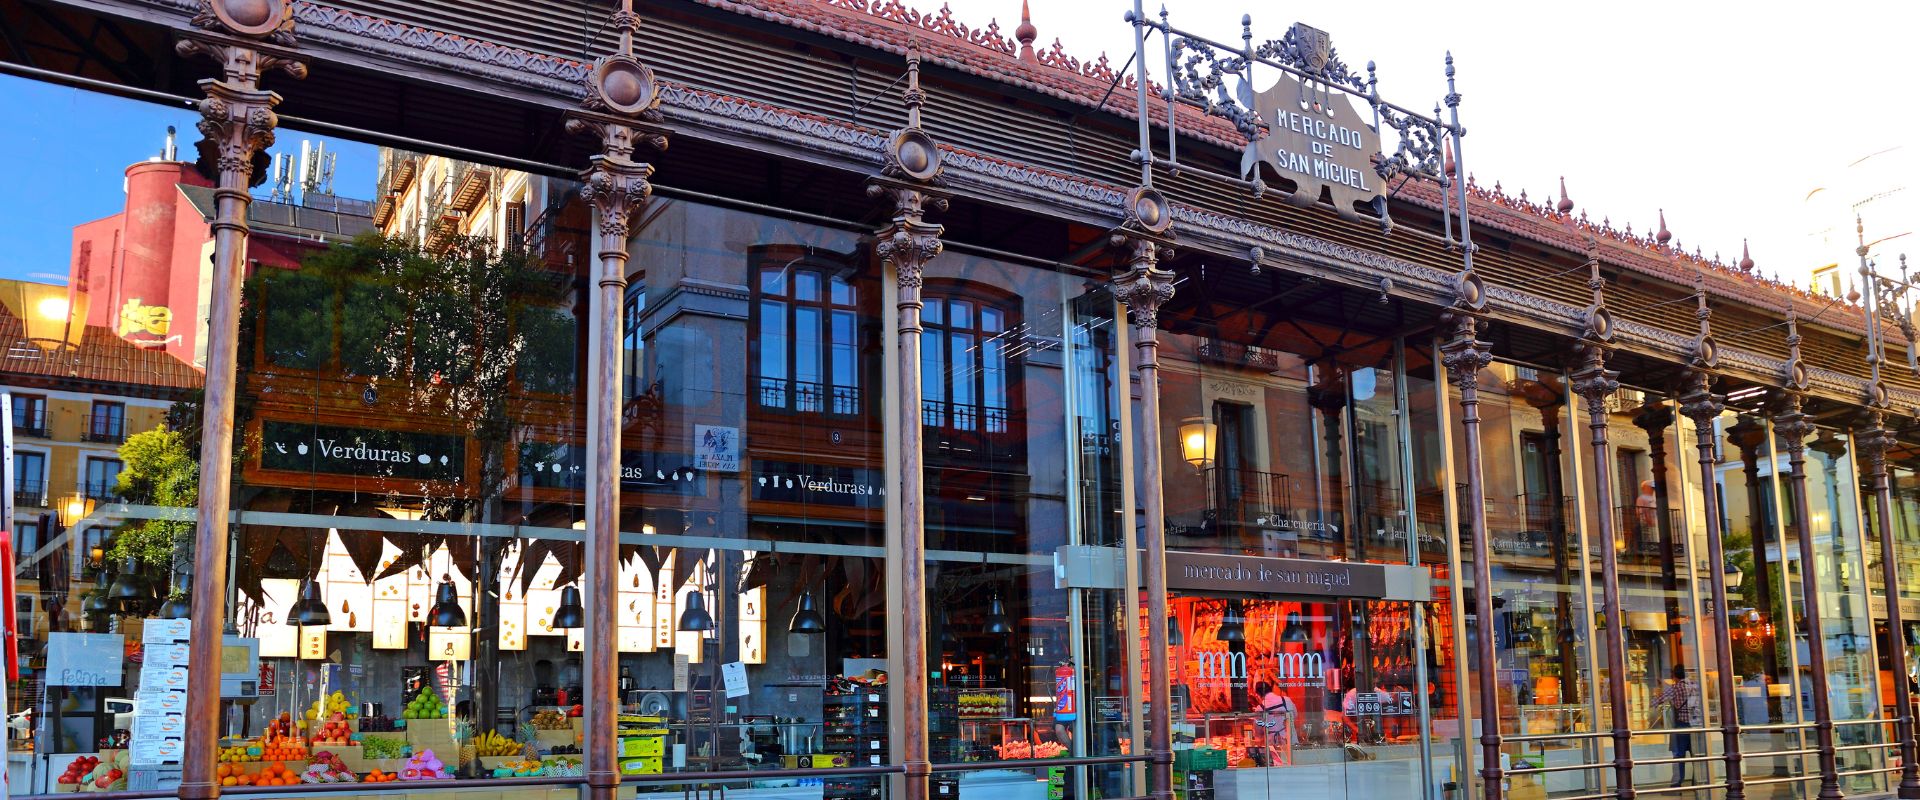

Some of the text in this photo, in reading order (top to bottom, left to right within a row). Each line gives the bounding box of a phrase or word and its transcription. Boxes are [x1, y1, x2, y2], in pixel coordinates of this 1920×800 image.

[1277, 108, 1362, 149] MERCADO
[1278, 149, 1310, 175] SAN
[1312, 141, 1334, 158] DE
[317, 439, 411, 463] Verduras
[797, 474, 866, 495] Verduras
[1184, 562, 1351, 592] mercado de san miguel
